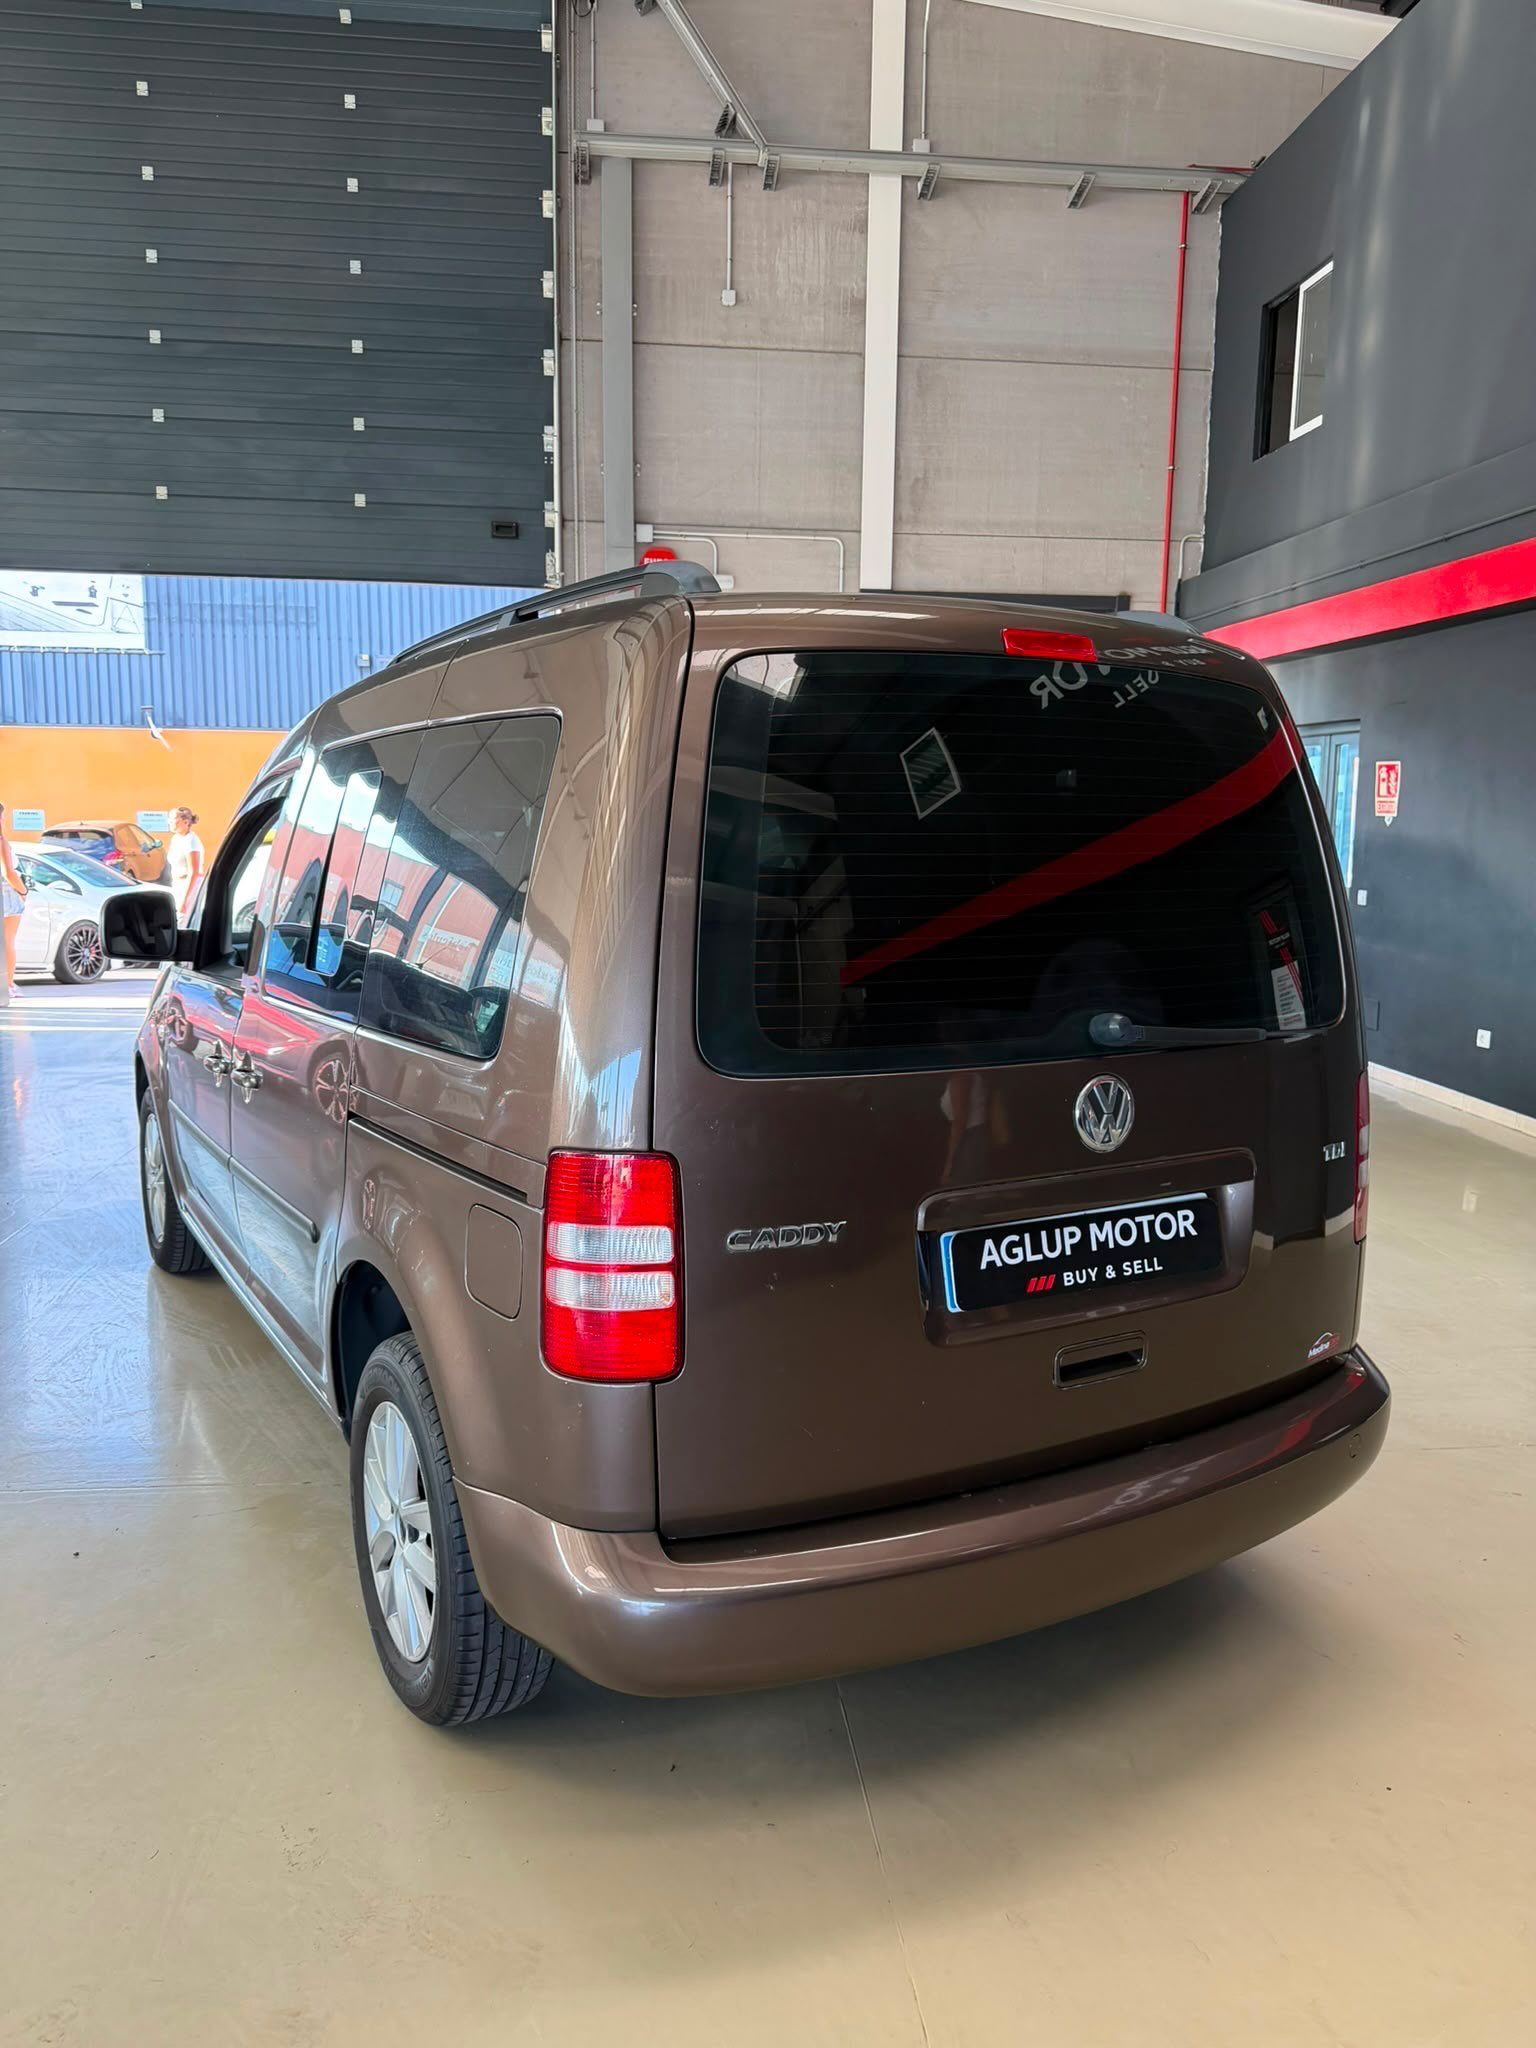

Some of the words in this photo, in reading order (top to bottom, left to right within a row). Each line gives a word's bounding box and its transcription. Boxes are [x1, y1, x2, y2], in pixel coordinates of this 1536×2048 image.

[1323, 1141, 1346, 1161] TDI
[726, 1220, 848, 1252] CADDY
[980, 1225, 1082, 1270] AGLUP
[1088, 1209, 1198, 1252] MOTOR
[1062, 1267, 1099, 1287] BUY
[1105, 1264, 1117, 1279] &
[1122, 1256, 1164, 1276] SELL
